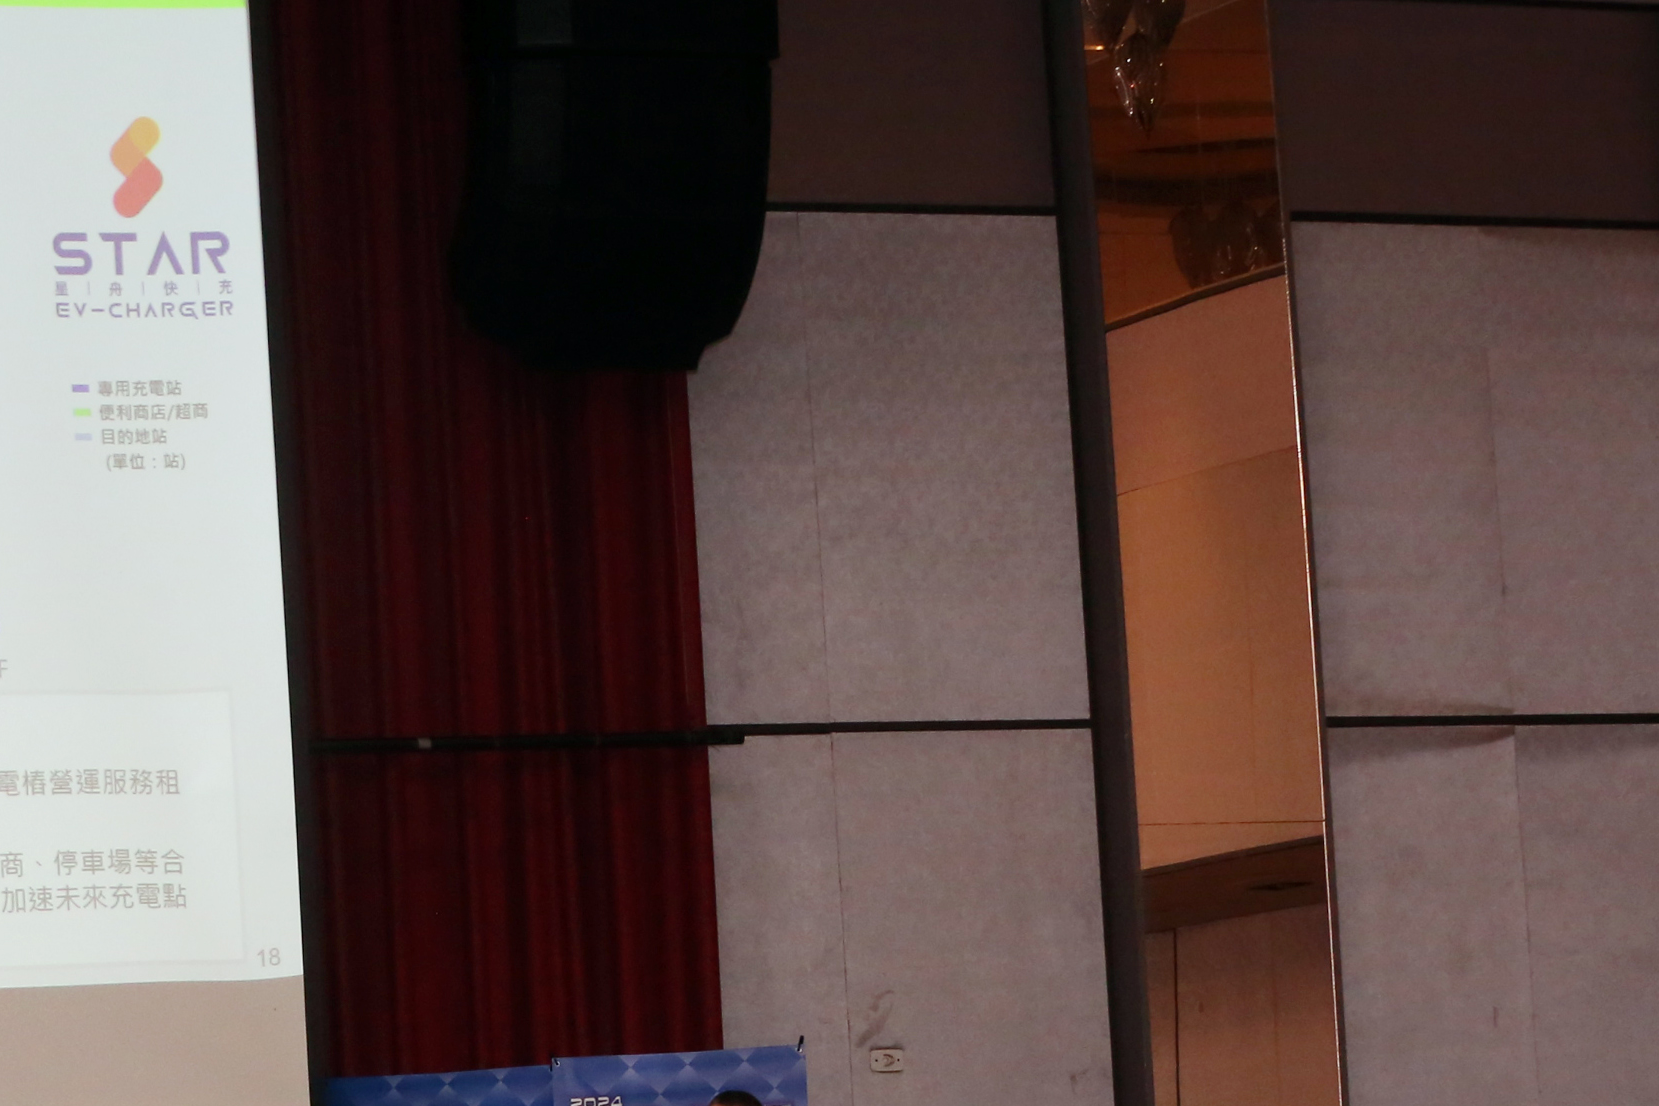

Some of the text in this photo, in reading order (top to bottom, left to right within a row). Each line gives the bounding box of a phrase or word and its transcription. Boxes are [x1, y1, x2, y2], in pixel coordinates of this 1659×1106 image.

[52, 231, 230, 276] STAR
[55, 300, 234, 320] EV-CHARGER
[97, 380, 183, 397] 專用充電站
[99, 403, 209, 421] 便利商店/超商
[101, 428, 168, 445] 目的地站
[257, 947, 281, 968] 18
